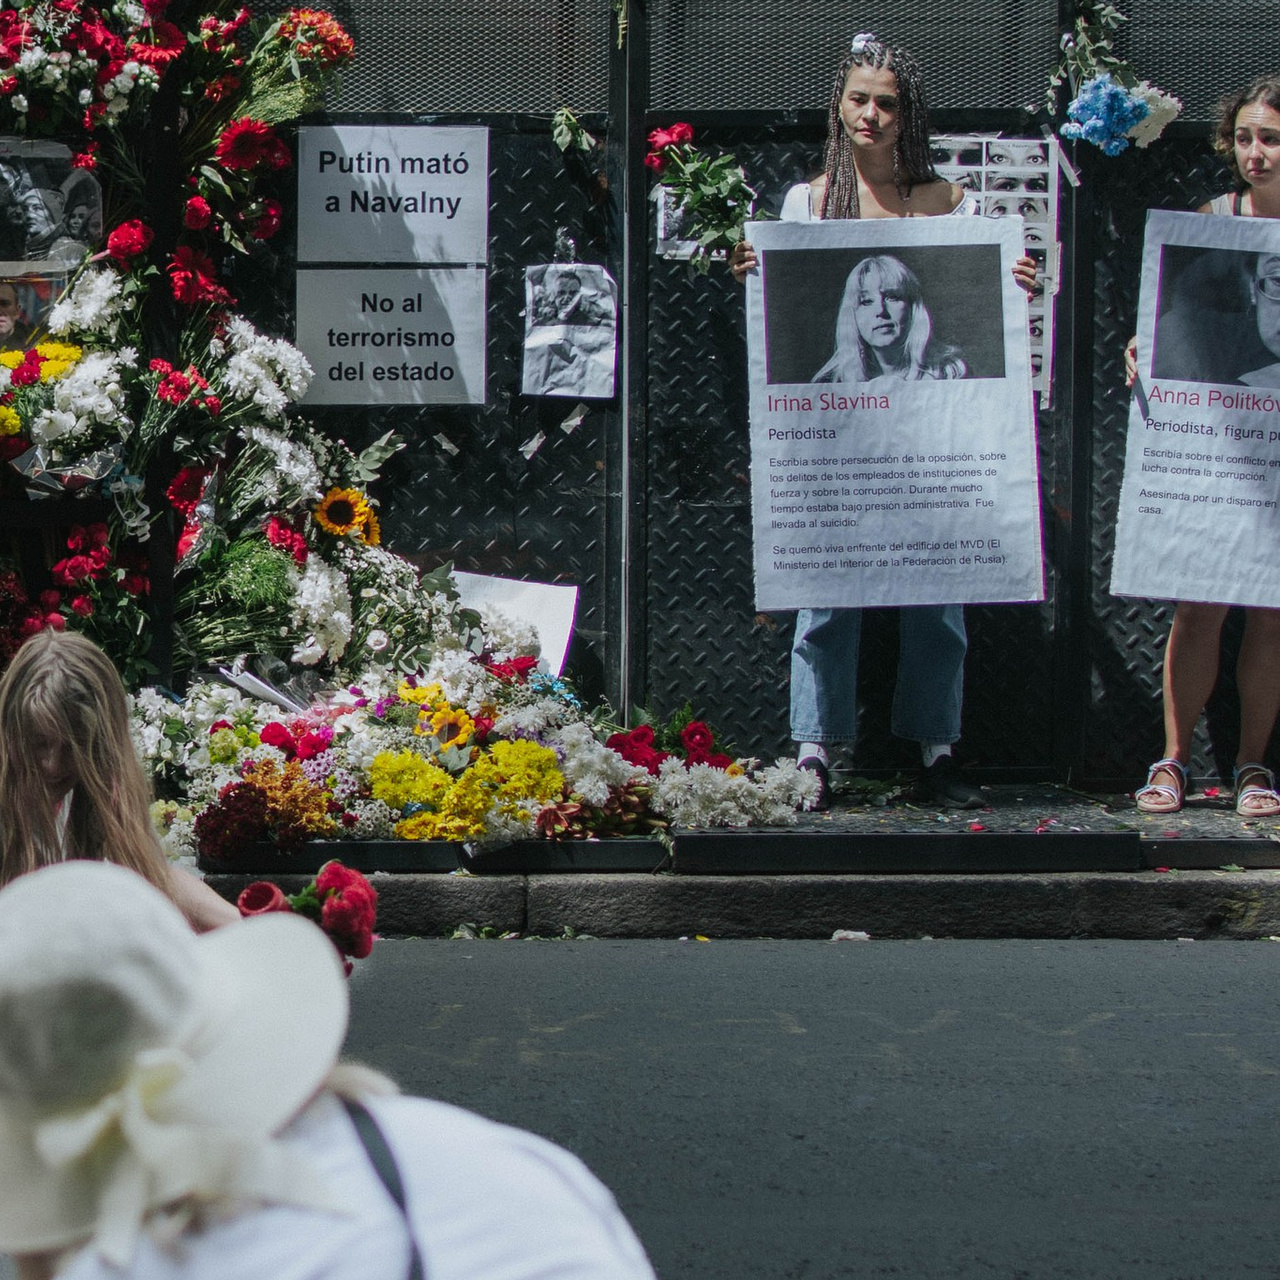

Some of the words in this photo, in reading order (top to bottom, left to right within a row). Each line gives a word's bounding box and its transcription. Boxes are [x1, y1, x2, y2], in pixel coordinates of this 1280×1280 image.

[319, 151, 390, 174] Putin
[400, 151, 469, 175] mató
[325, 196, 340, 213] a
[350, 191, 462, 219] Navalny
[361, 293, 394, 313] No
[402, 293, 422, 313] al
[327, 328, 455, 347] terrorismo
[328, 362, 364, 381] del
[372, 362, 454, 381] estado
[768, 395, 812, 411] Irina
[820, 393, 889, 410] Slavina
[1148, 386, 1200, 406] Anna
[768, 427, 836, 440] Periodista
[1146, 419, 1218, 438] Periodista,
[1225, 425, 1264, 440] figura
[811, 457, 838, 466] sobre
[841, 454, 898, 466] persecución
[902, 454, 913, 463] de
[917, 454, 925, 462] la
[980, 453, 1006, 461] sobre
[1185, 453, 1212, 461] sobre
[1215, 454, 1223, 462] el
[1226, 455, 1266, 466] conflicto
[770, 474, 783, 482] los
[787, 473, 818, 482] delitos
[821, 473, 833, 481] de
[836, 472, 850, 480] los
[853, 470, 905, 481] empleados
[908, 470, 919, 478] de
[923, 469, 981, 478] instituciones
[1142, 463, 1167, 473] lucha
[1170, 467, 1200, 475] contra
[1203, 469, 1211, 477] la
[1215, 470, 1267, 481] corrupción.
[771, 489, 800, 498] fuerza
[803, 491, 808, 499] y
[812, 488, 838, 496] sobre
[841, 487, 850, 495] la
[853, 486, 906, 496] corrupción.
[909, 484, 947, 494] Durante
[950, 484, 983, 492] mucho
[1139, 489, 1190, 501] Asesinada
[1193, 495, 1208, 503] por
[1226, 497, 1262, 507] disparo
[771, 505, 803, 514] tiempo
[807, 504, 838, 512] estaba
[842, 503, 862, 512] bajo
[865, 501, 900, 512] presión
[976, 499, 994, 507] Fue
[1138, 506, 1163, 514] casa.
[771, 520, 806, 529] llevada
[809, 519, 817, 527] al
[820, 519, 859, 527] suicidio.
[773, 546, 786, 554] Se
[789, 545, 822, 555] quemó
[825, 545, 843, 553] viva
[847, 544, 886, 552] enfrente
[890, 542, 903, 551] del
[907, 542, 940, 550] edificio
[943, 541, 957, 549] del
[960, 540, 984, 549] MVD
[774, 561, 819, 570] Ministerio
[822, 560, 837, 568] del
[840, 560, 873, 568] Interior
[876, 559, 888, 567] de
[892, 558, 899, 566] la
[902, 558, 956, 566] Federación
[959, 556, 971, 564] de
[974, 555, 1007, 564] Rusia).
